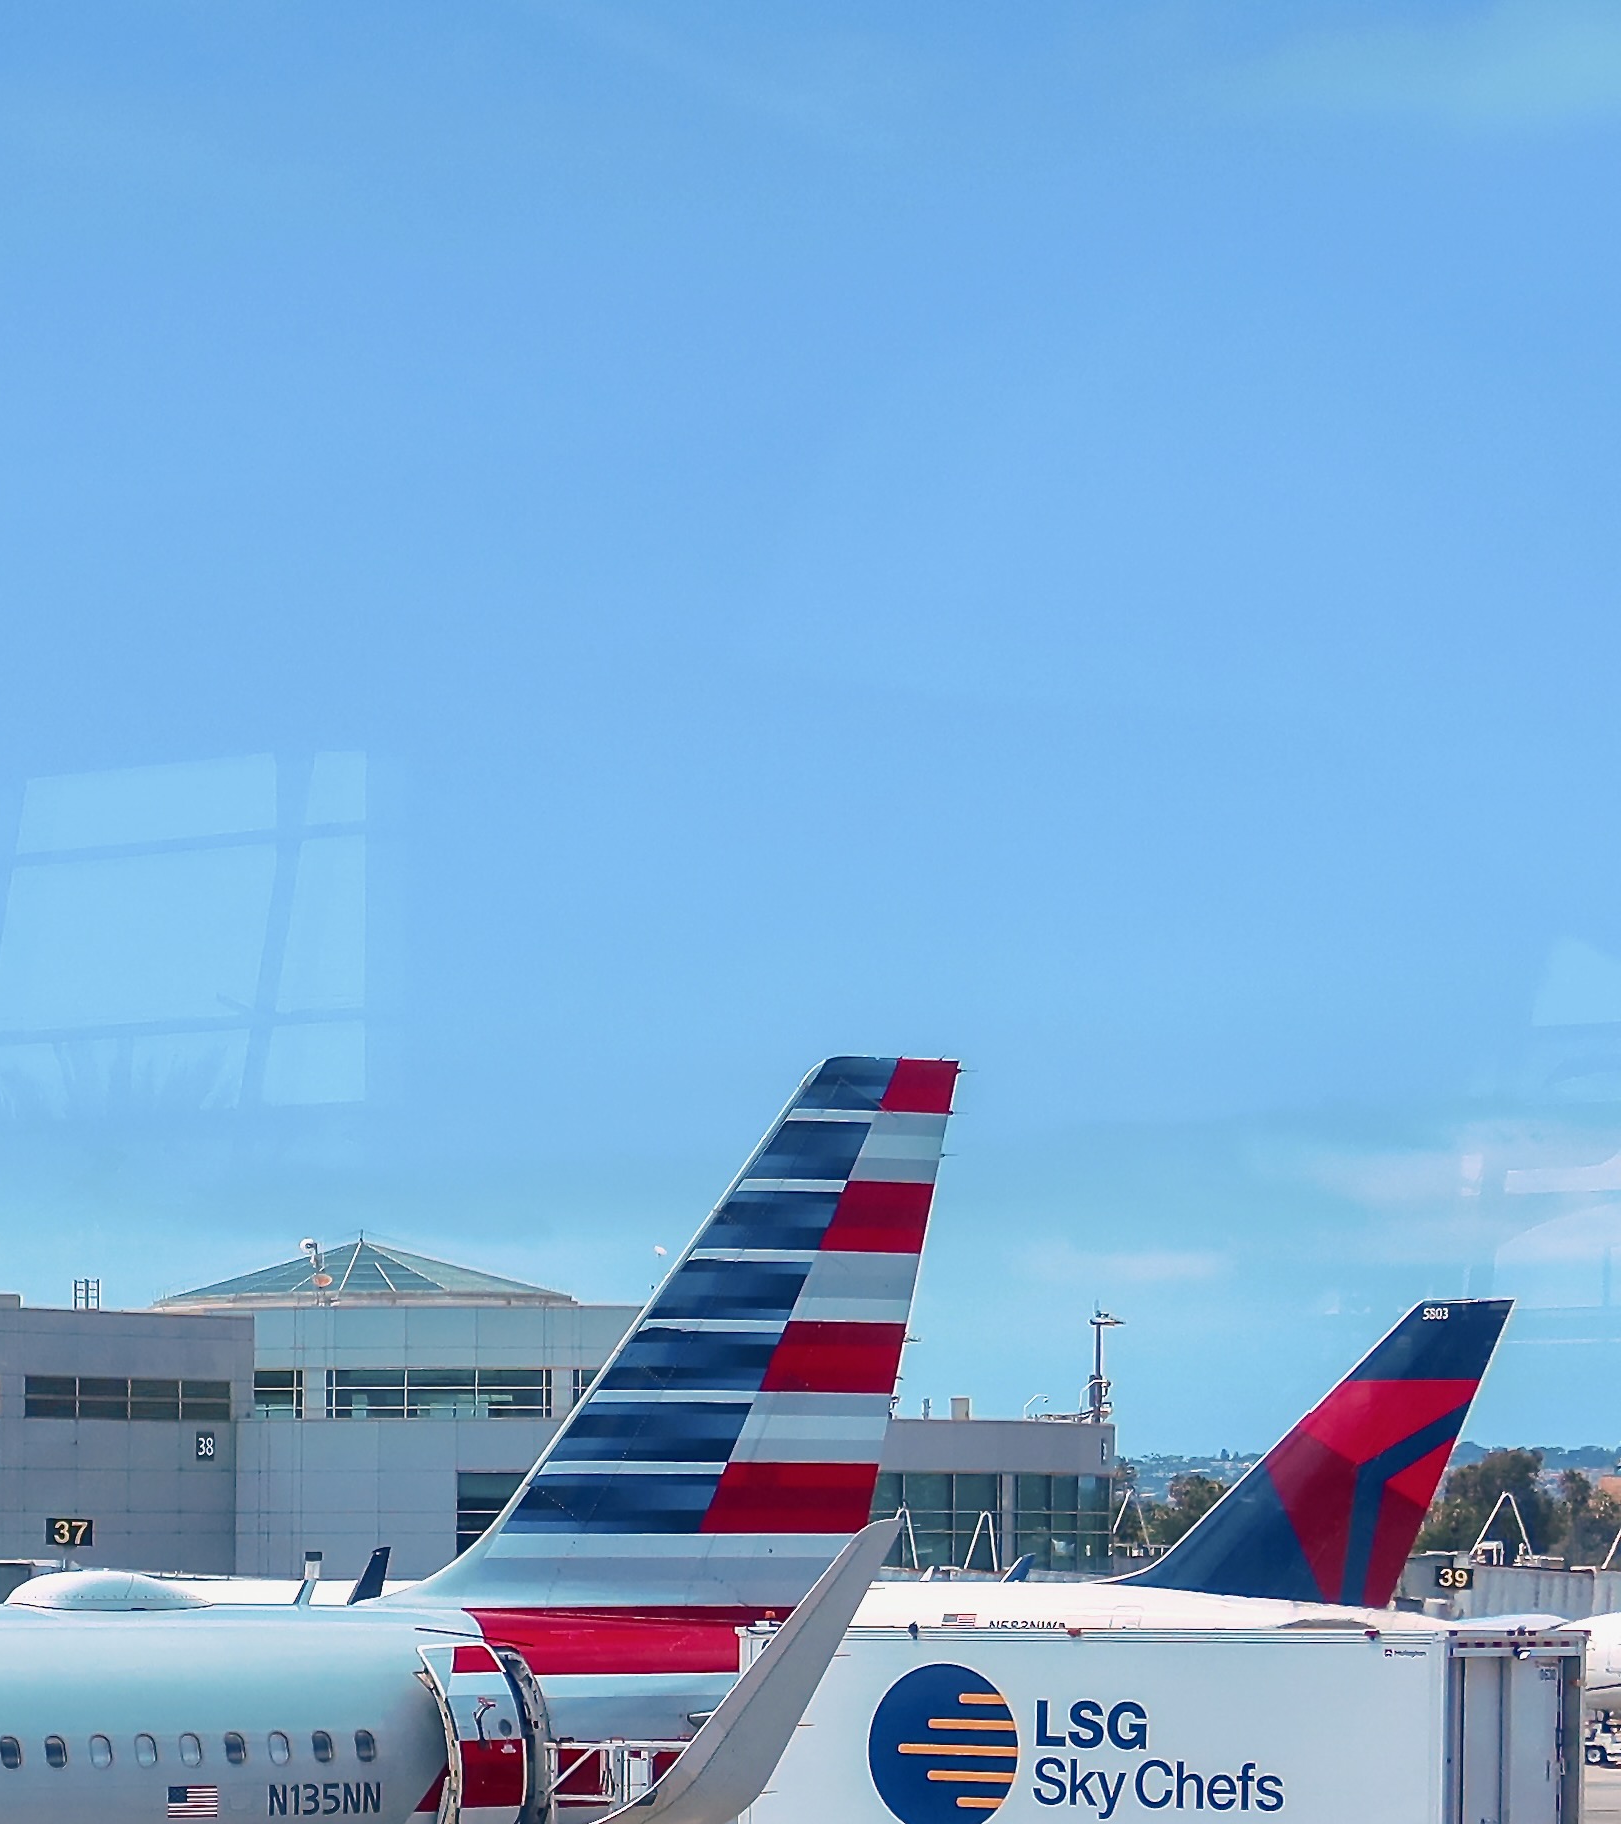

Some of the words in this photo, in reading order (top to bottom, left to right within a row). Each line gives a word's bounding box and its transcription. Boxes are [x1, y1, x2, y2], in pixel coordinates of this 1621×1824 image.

[197, 1437, 214, 1456] 38
[53, 1520, 88, 1546] 37
[1438, 1568, 1468, 1588] 39
[1035, 1699, 1148, 1751] LSG
[268, 1781, 381, 1817] N135NN
[1032, 1756, 1127, 1820] Sky
[1134, 1759, 1285, 1812] Chefs
